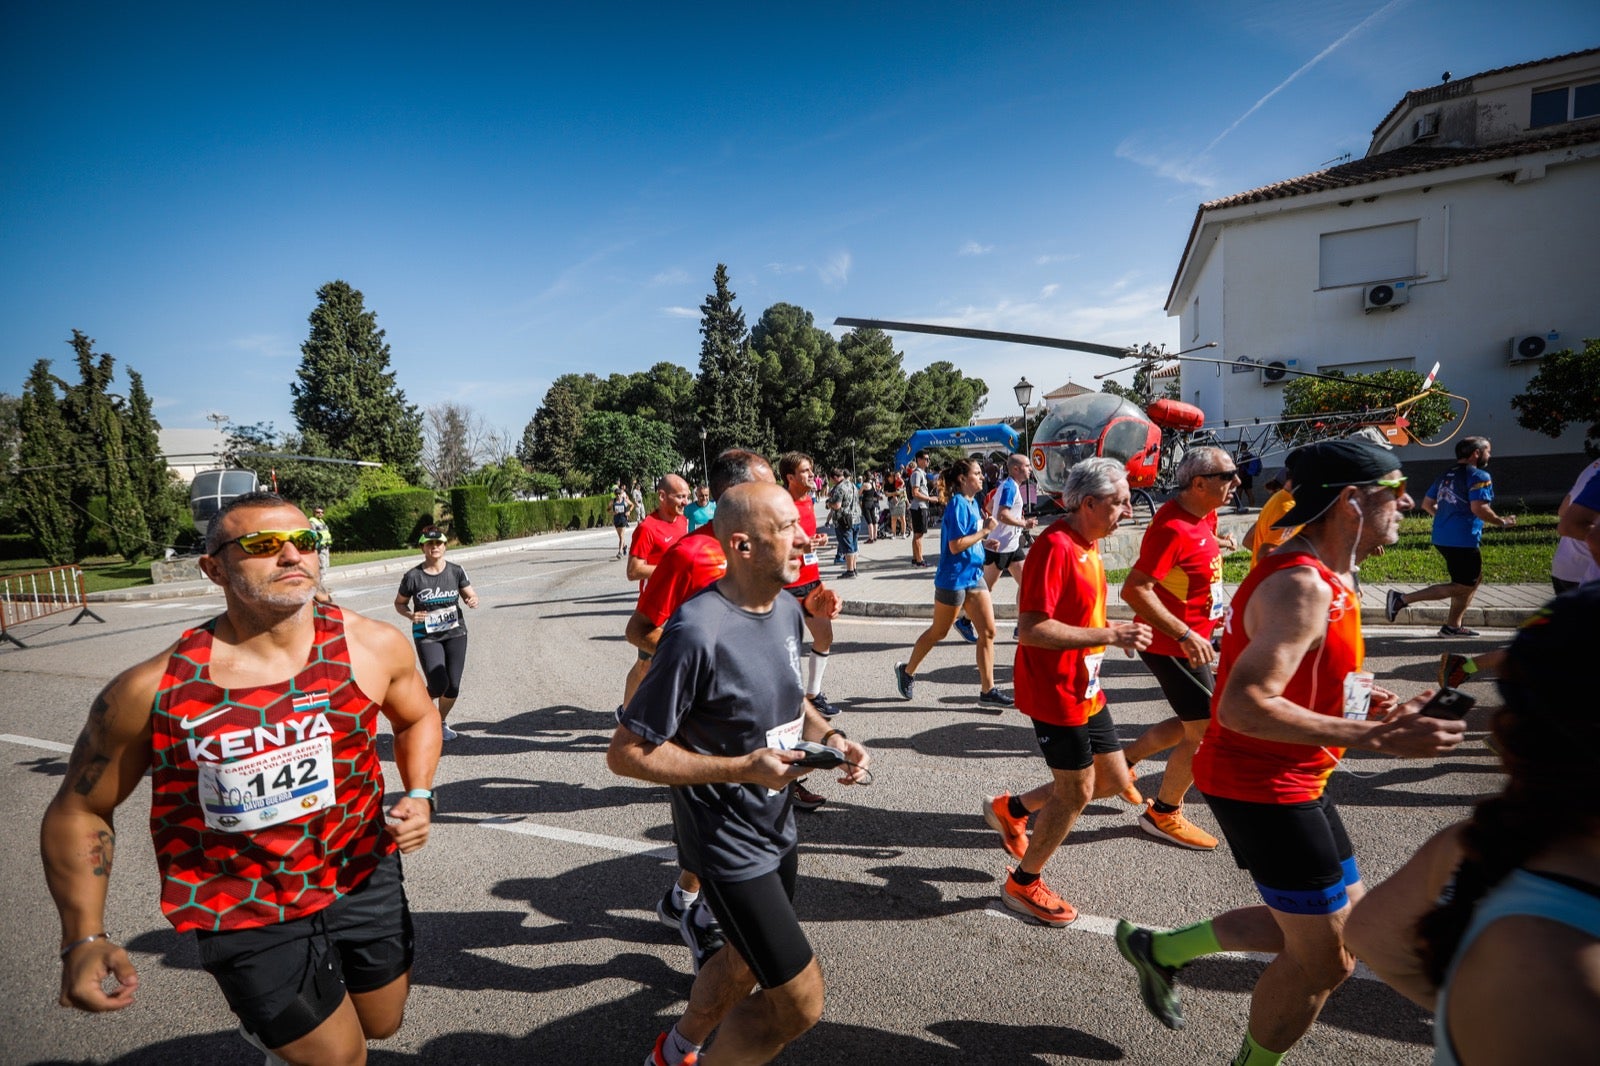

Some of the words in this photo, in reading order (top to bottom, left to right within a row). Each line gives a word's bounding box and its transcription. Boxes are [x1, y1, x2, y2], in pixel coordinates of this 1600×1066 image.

[186, 712, 335, 761] KENYA
[224, 759, 268, 775] CARRERA
[270, 751, 292, 763] BASE
[247, 757, 319, 798] 142
